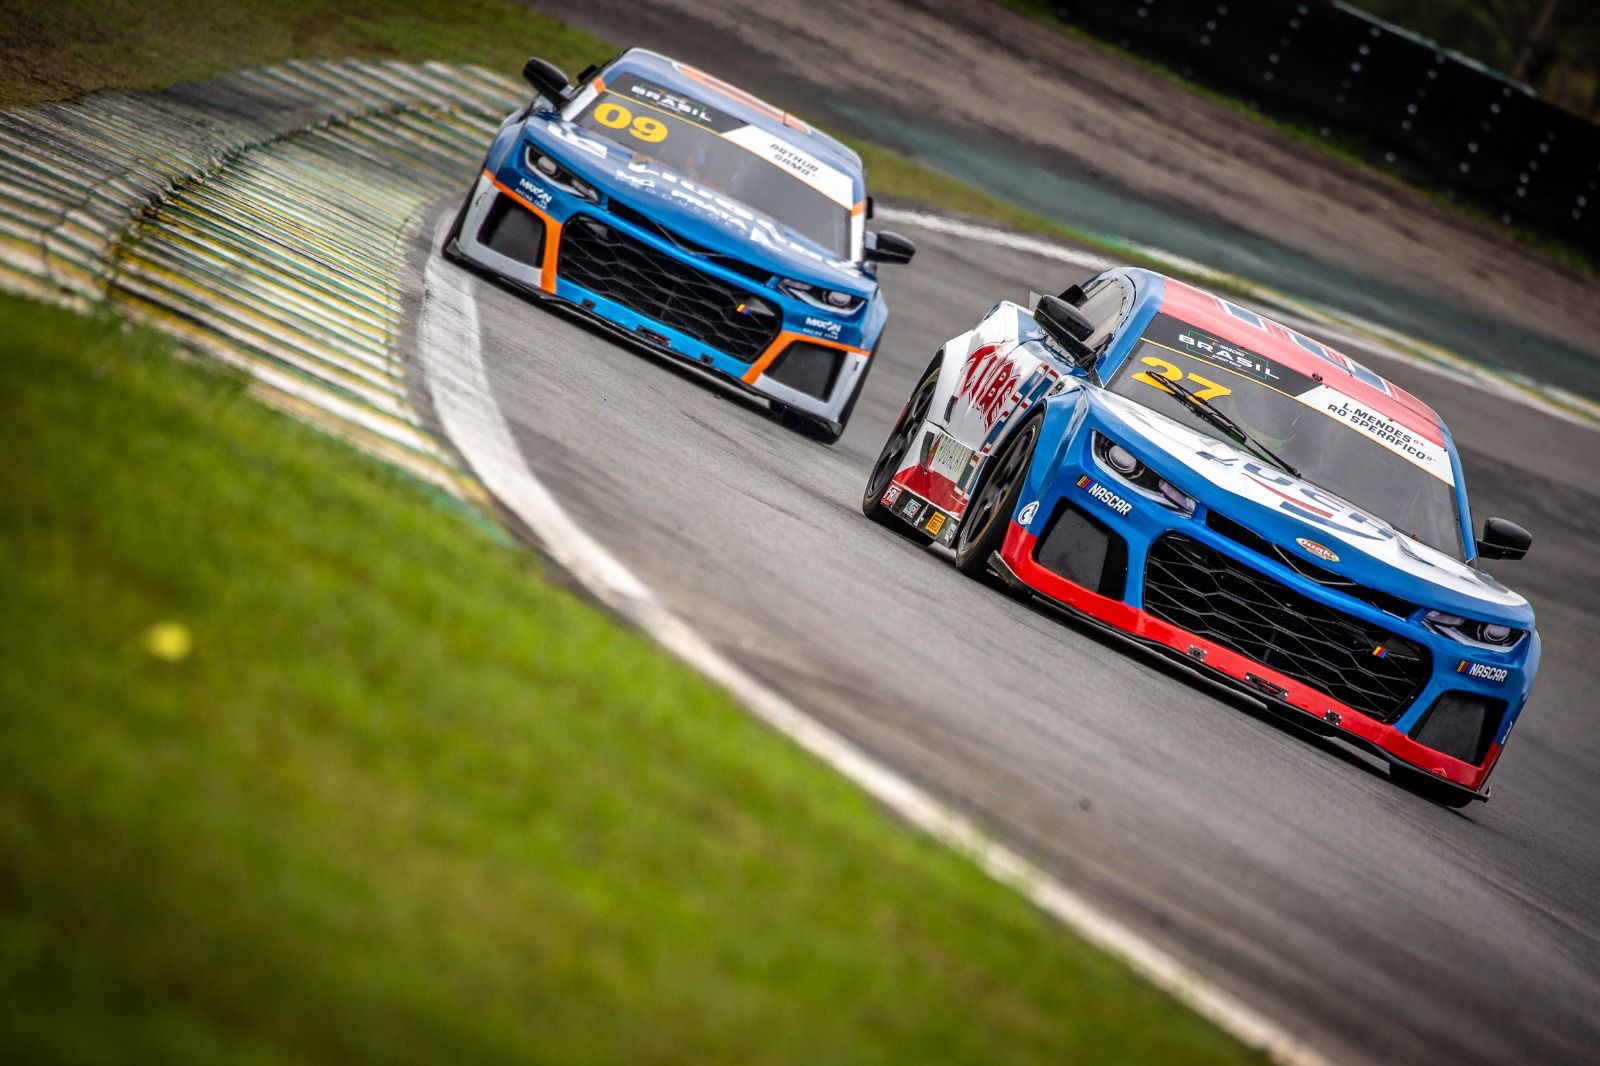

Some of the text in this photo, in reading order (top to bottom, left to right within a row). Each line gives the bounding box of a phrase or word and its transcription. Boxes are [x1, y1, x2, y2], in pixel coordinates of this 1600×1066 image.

[593, 102, 669, 143] 09
[631, 85, 712, 122] BRASIL
[1178, 333, 1280, 381] BRASIL
[1131, 356, 1233, 405] 27
[1350, 415, 1426, 460] SPERAFICO
[1087, 482, 1133, 516] NASCAR
[1468, 662, 1508, 683] NASCAR
